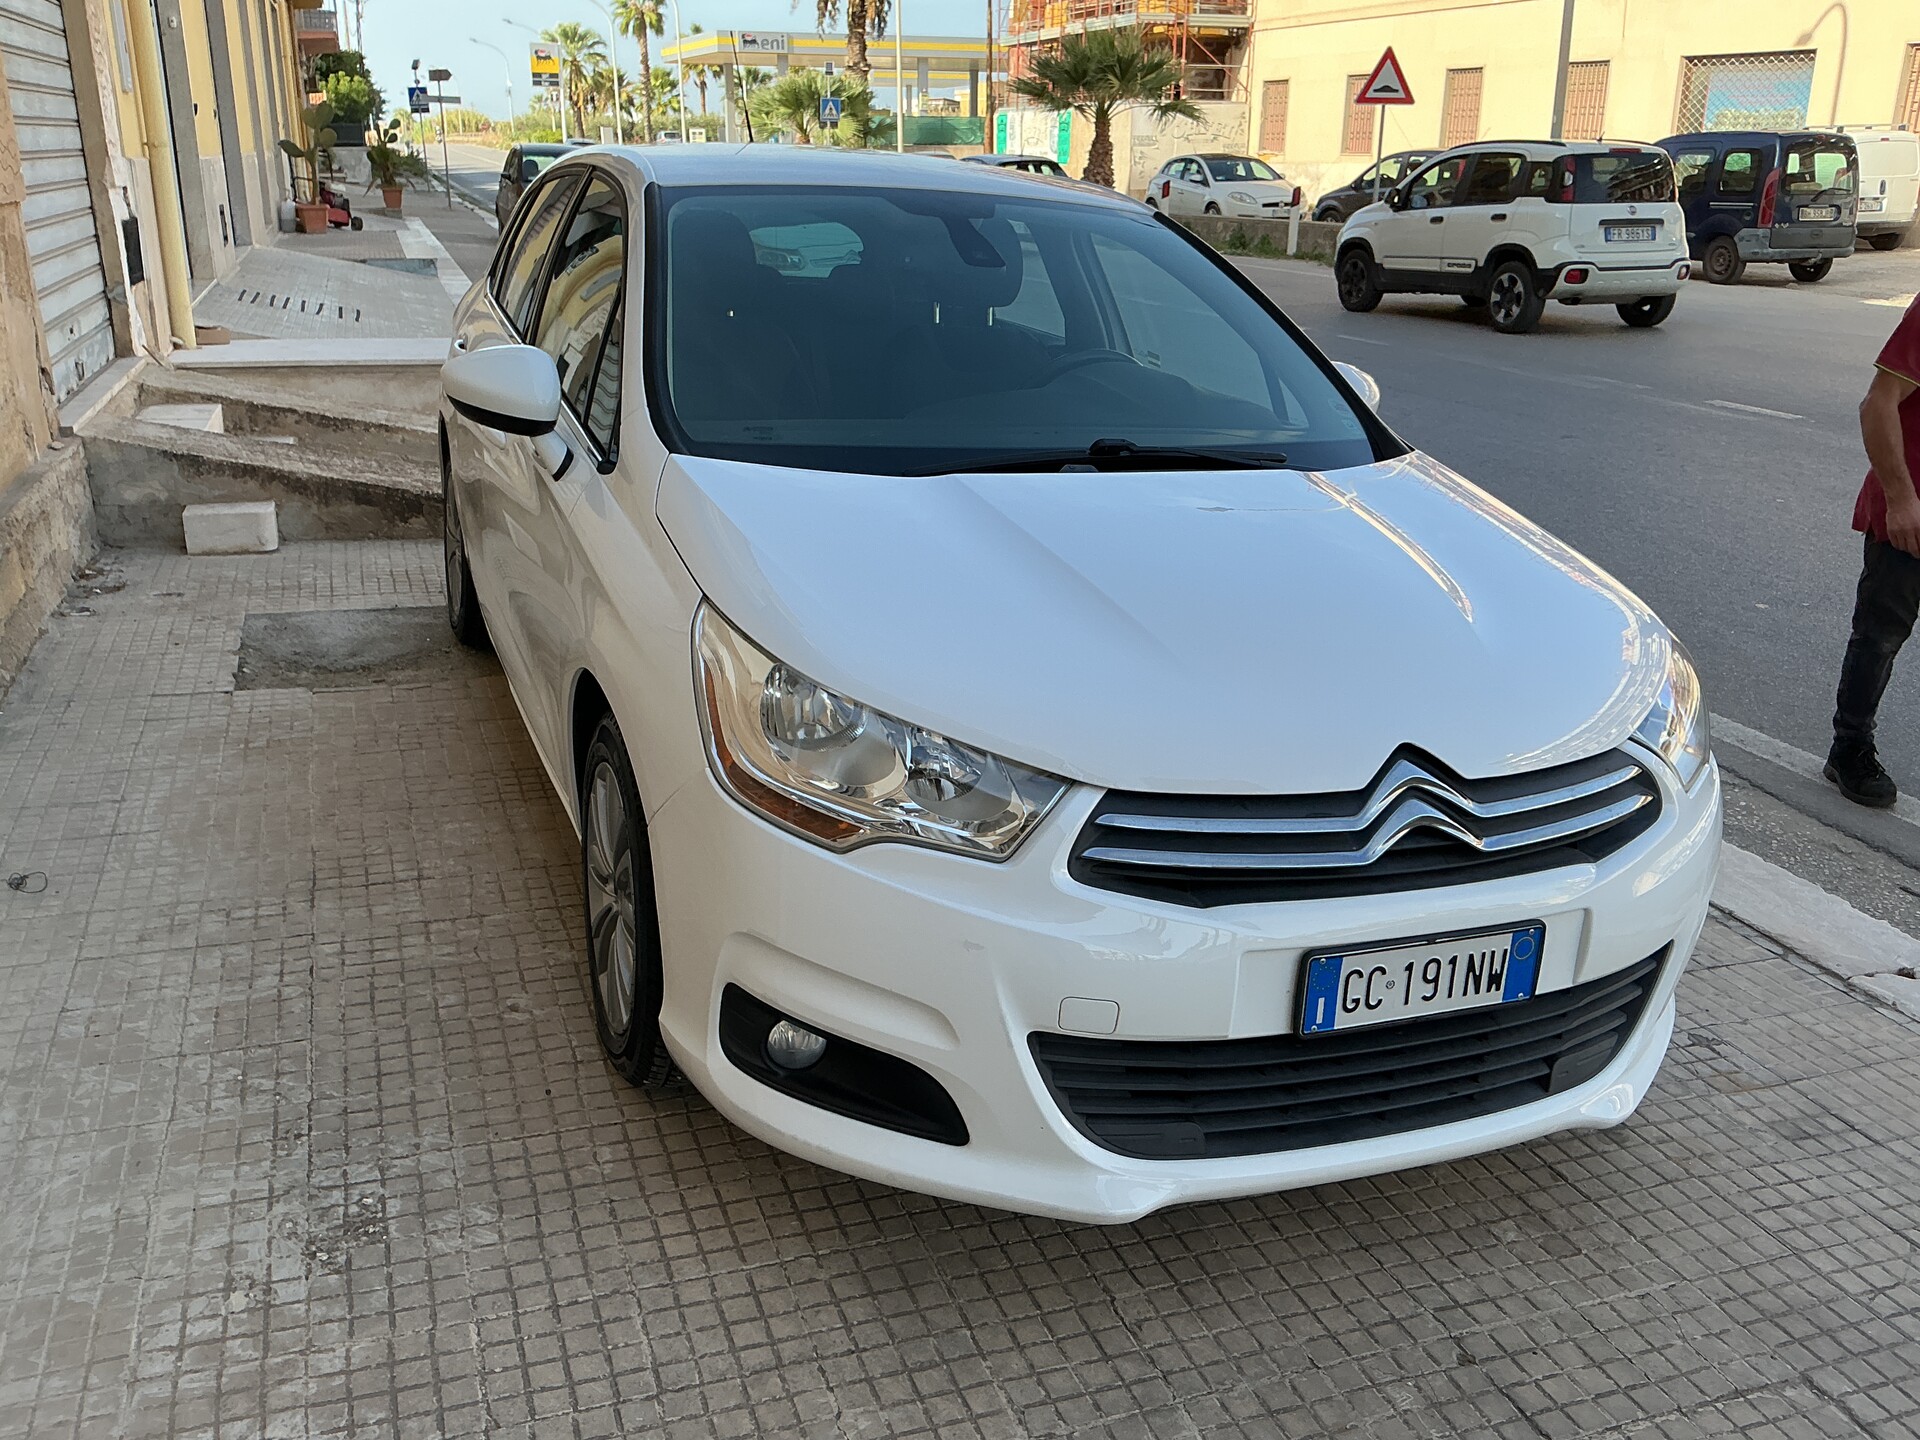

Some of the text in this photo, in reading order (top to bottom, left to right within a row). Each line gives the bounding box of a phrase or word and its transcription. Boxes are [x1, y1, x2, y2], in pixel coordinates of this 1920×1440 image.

[760, 34, 785, 51] eni
[1342, 965, 1387, 1014] GC
[1402, 947, 1510, 1006] 191NW
